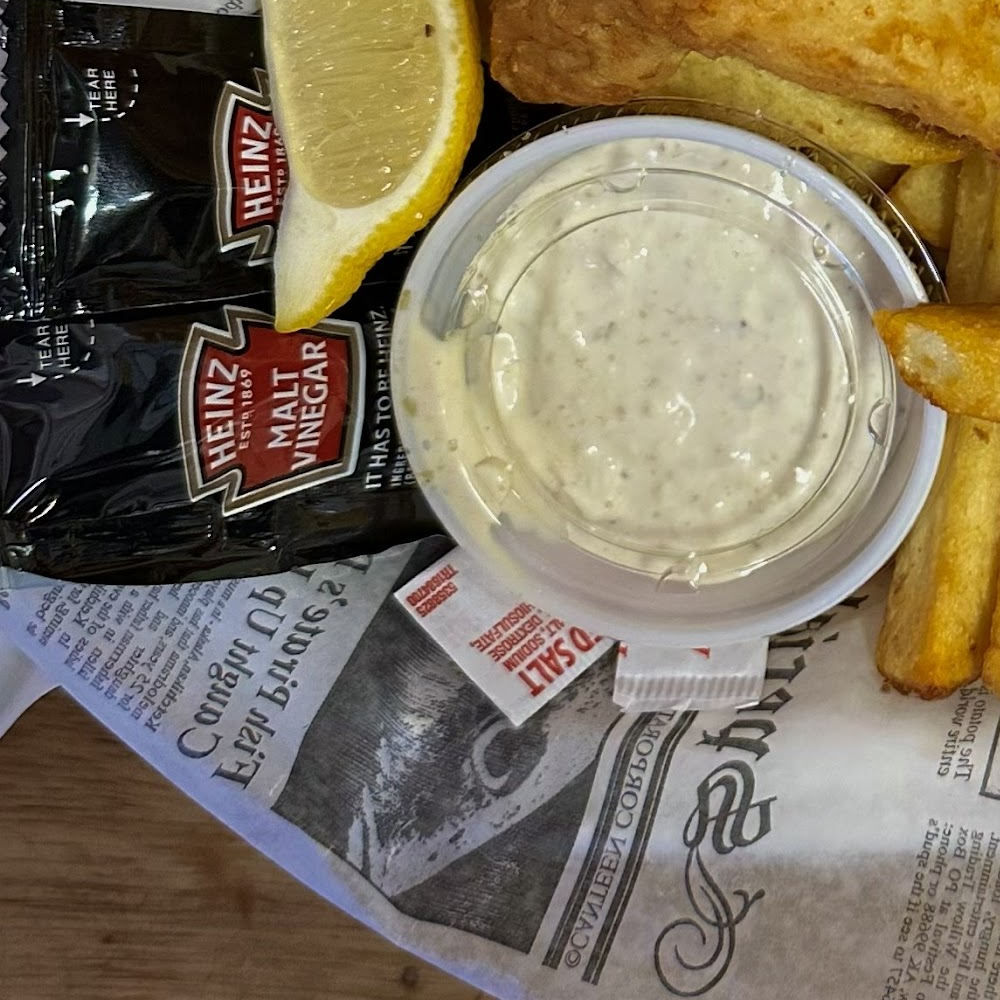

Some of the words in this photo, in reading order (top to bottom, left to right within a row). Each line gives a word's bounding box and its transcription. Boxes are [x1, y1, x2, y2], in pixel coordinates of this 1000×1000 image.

[87, 67, 101, 110] TEAR
[103, 69, 117, 110] HERE
[243, 117, 272, 219] HEINZ
[37, 324, 51, 369] TEAR
[55, 322, 71, 366] HERE
[240, 368, 253, 405] 1869
[266, 367, 300, 450] MALT
[291, 338, 331, 472] VINEGAR
[374, 394, 394, 421] TO
[207, 359, 238, 469] HEINZ
[368, 425, 392, 467] HAS
[364, 470, 383, 490] IT
[488, 615, 542, 662] DEXTROSE
[502, 634, 544, 671] SODIUM
[518, 640, 575, 696] SALT
